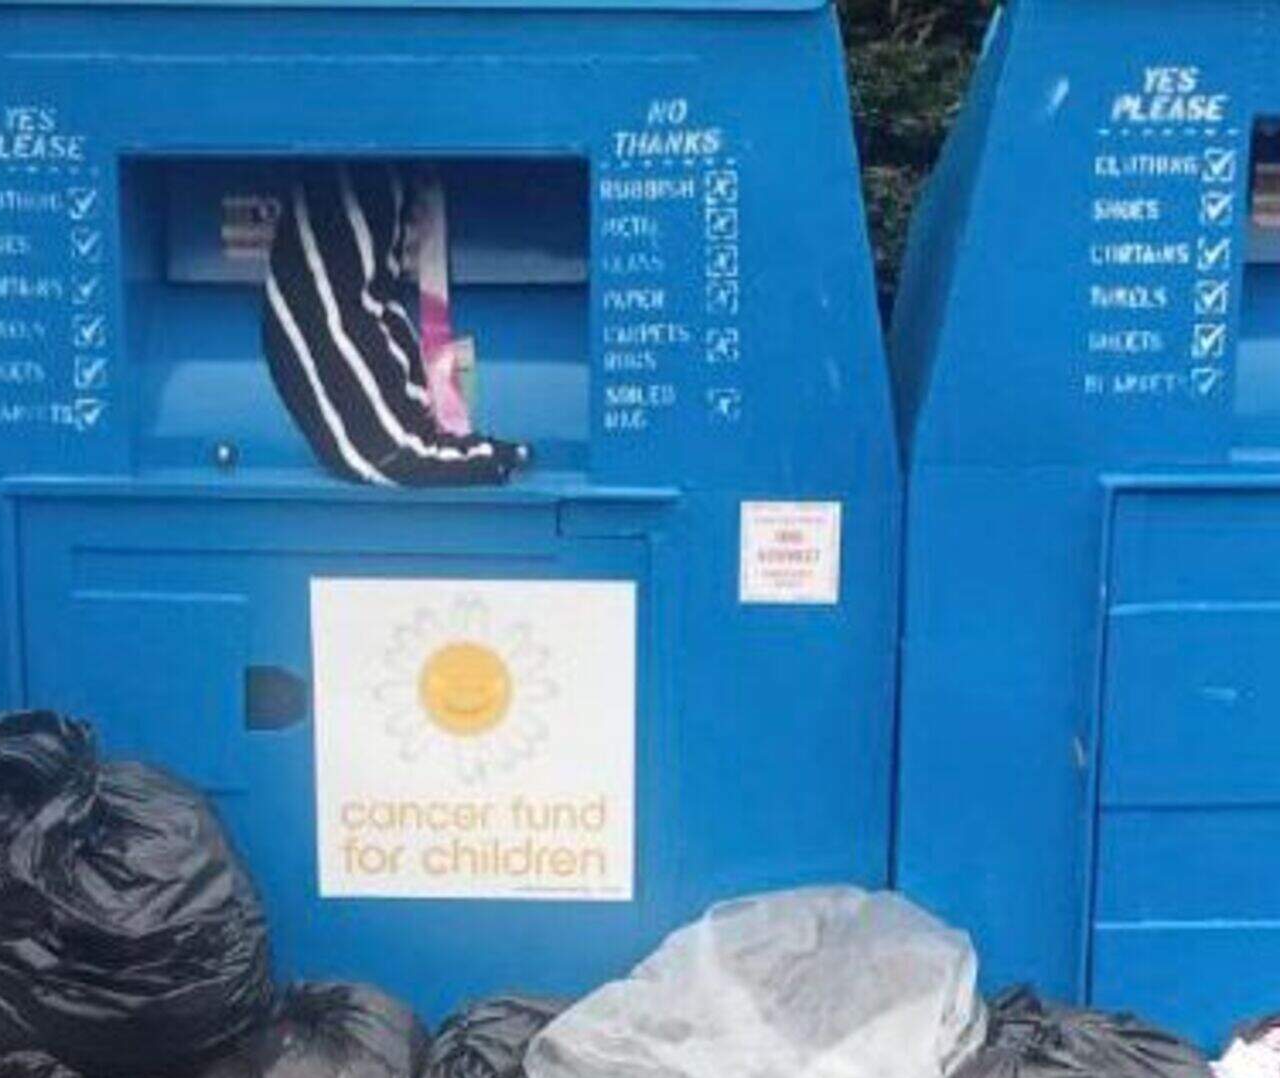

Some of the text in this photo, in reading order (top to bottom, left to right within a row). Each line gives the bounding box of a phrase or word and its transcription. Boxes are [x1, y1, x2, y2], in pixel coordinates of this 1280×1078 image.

[1144, 67, 1200, 94] YES
[5, 106, 57, 131] YES
[648, 99, 687, 124] NO
[1111, 94, 1230, 121] PLEASE
[613, 129, 721, 156] THANKS
[600, 178, 694, 200] RUBBISH
[1093, 199, 1161, 222] SHOES
[340, 795, 606, 831] cancer fund
[343, 835, 606, 876] for children
